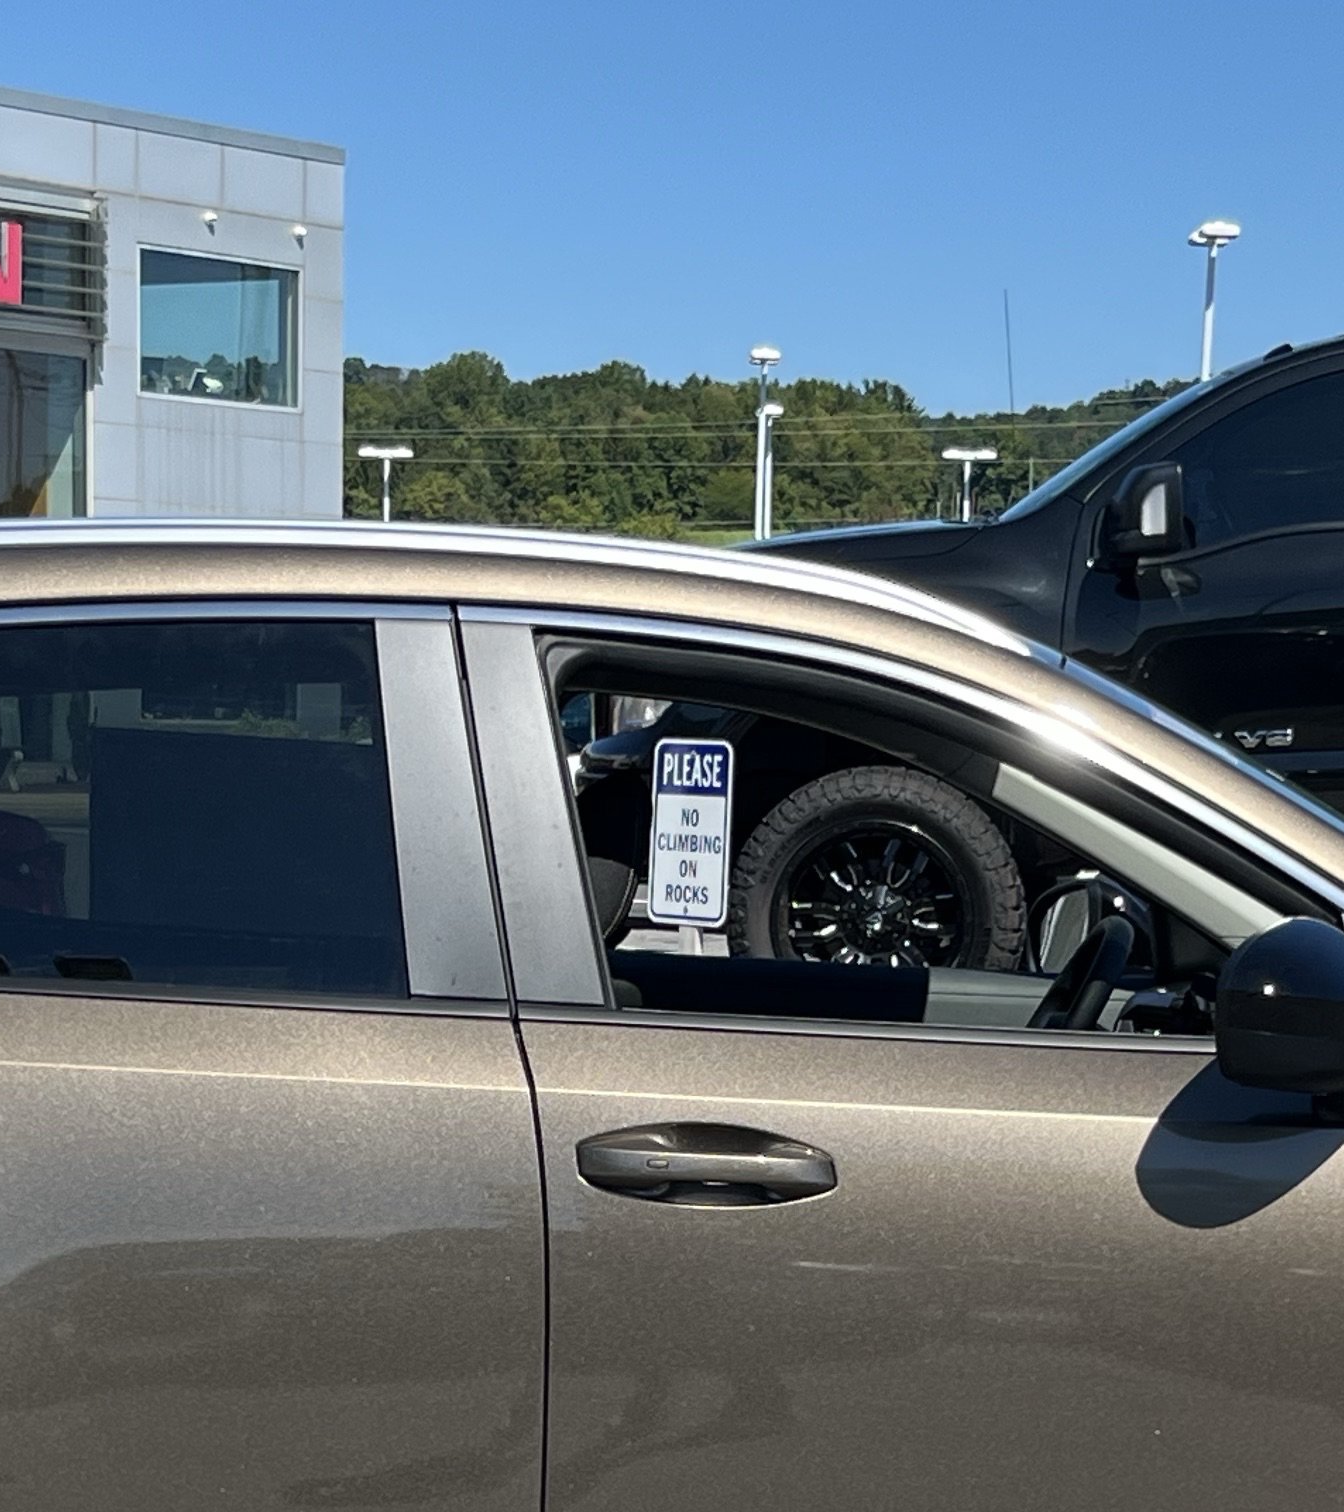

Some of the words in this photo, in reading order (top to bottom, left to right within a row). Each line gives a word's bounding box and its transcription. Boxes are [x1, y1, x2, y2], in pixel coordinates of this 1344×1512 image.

[662, 753, 723, 788] PLEASE
[681, 808, 699, 828] NO
[657, 833, 722, 855] CLIMBING
[678, 860, 698, 879] ON
[664, 884, 709, 905] ROCKS
